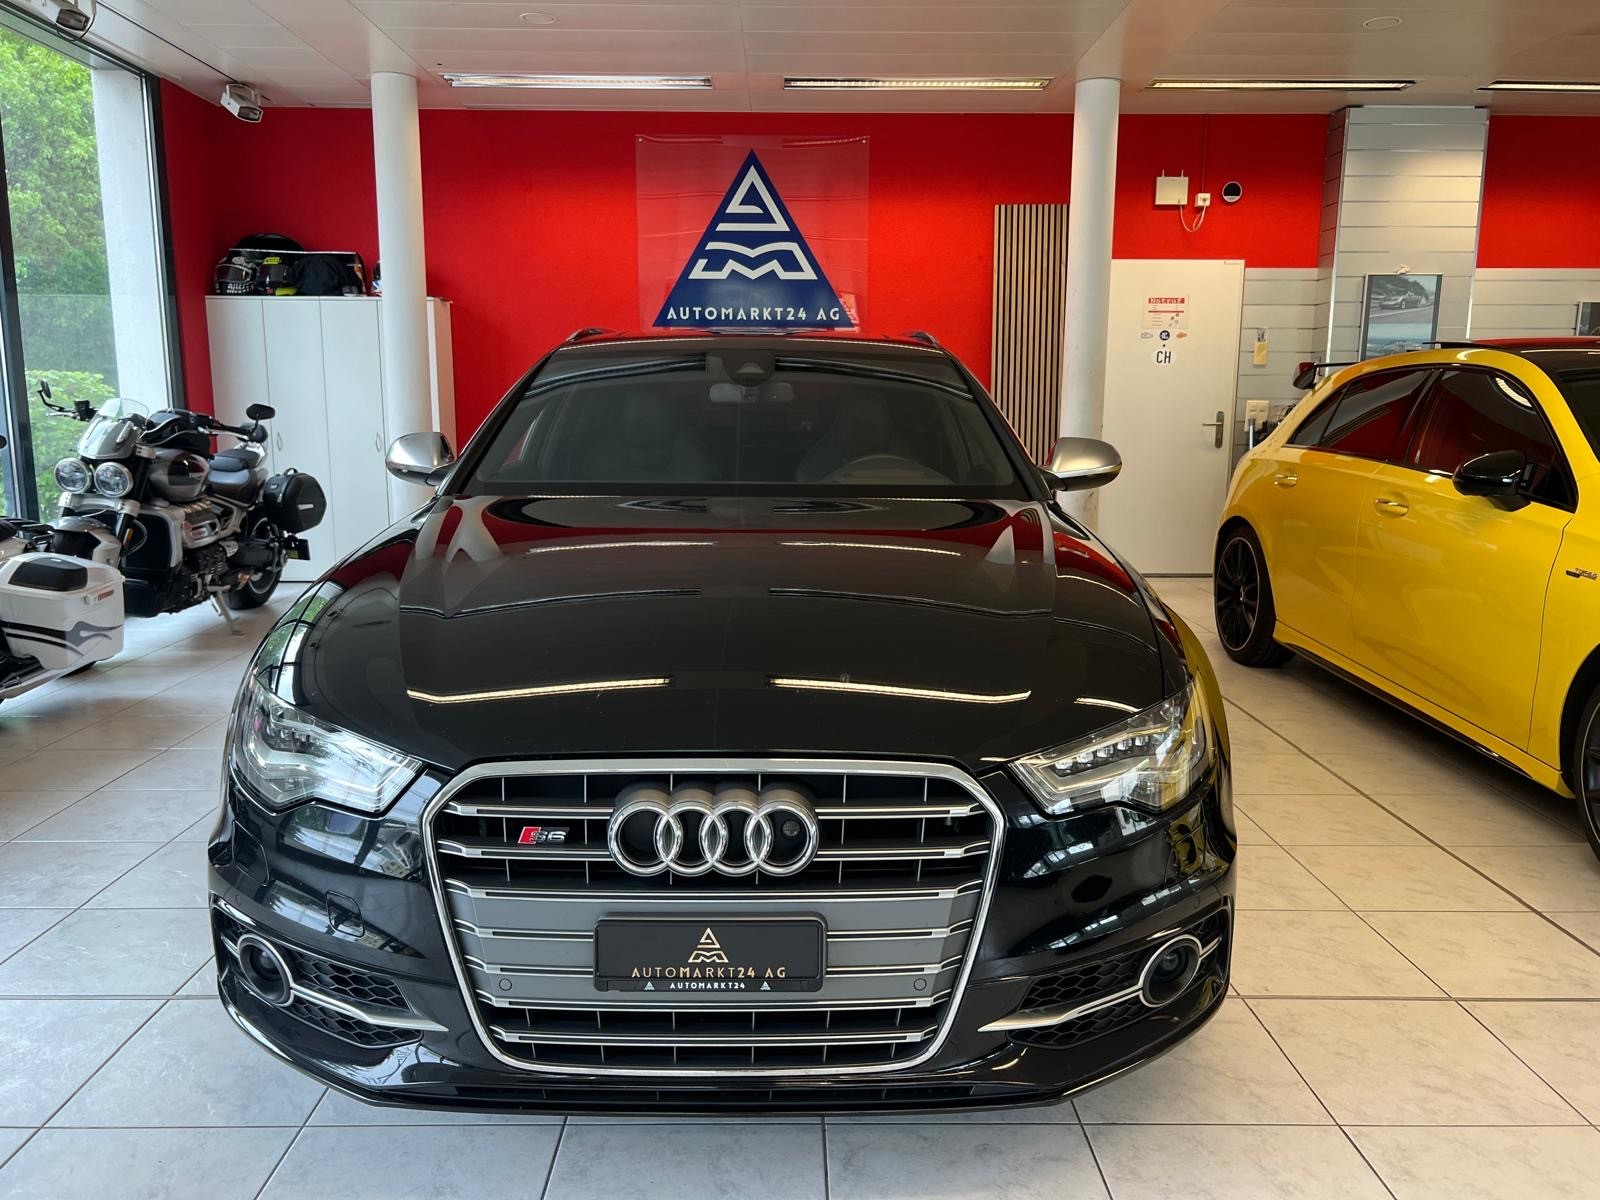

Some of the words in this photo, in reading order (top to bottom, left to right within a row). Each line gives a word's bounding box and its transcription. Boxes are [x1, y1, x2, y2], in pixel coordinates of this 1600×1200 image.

[666, 306, 807, 321] AUTOMARKT24
[816, 307, 840, 321] AG
[1156, 350, 1172, 364] CH
[529, 830, 567, 842] S6
[631, 966, 756, 978] AUTOMARKT24
[764, 966, 786, 978] AG
[669, 981, 746, 990] AUTOMARKT24
